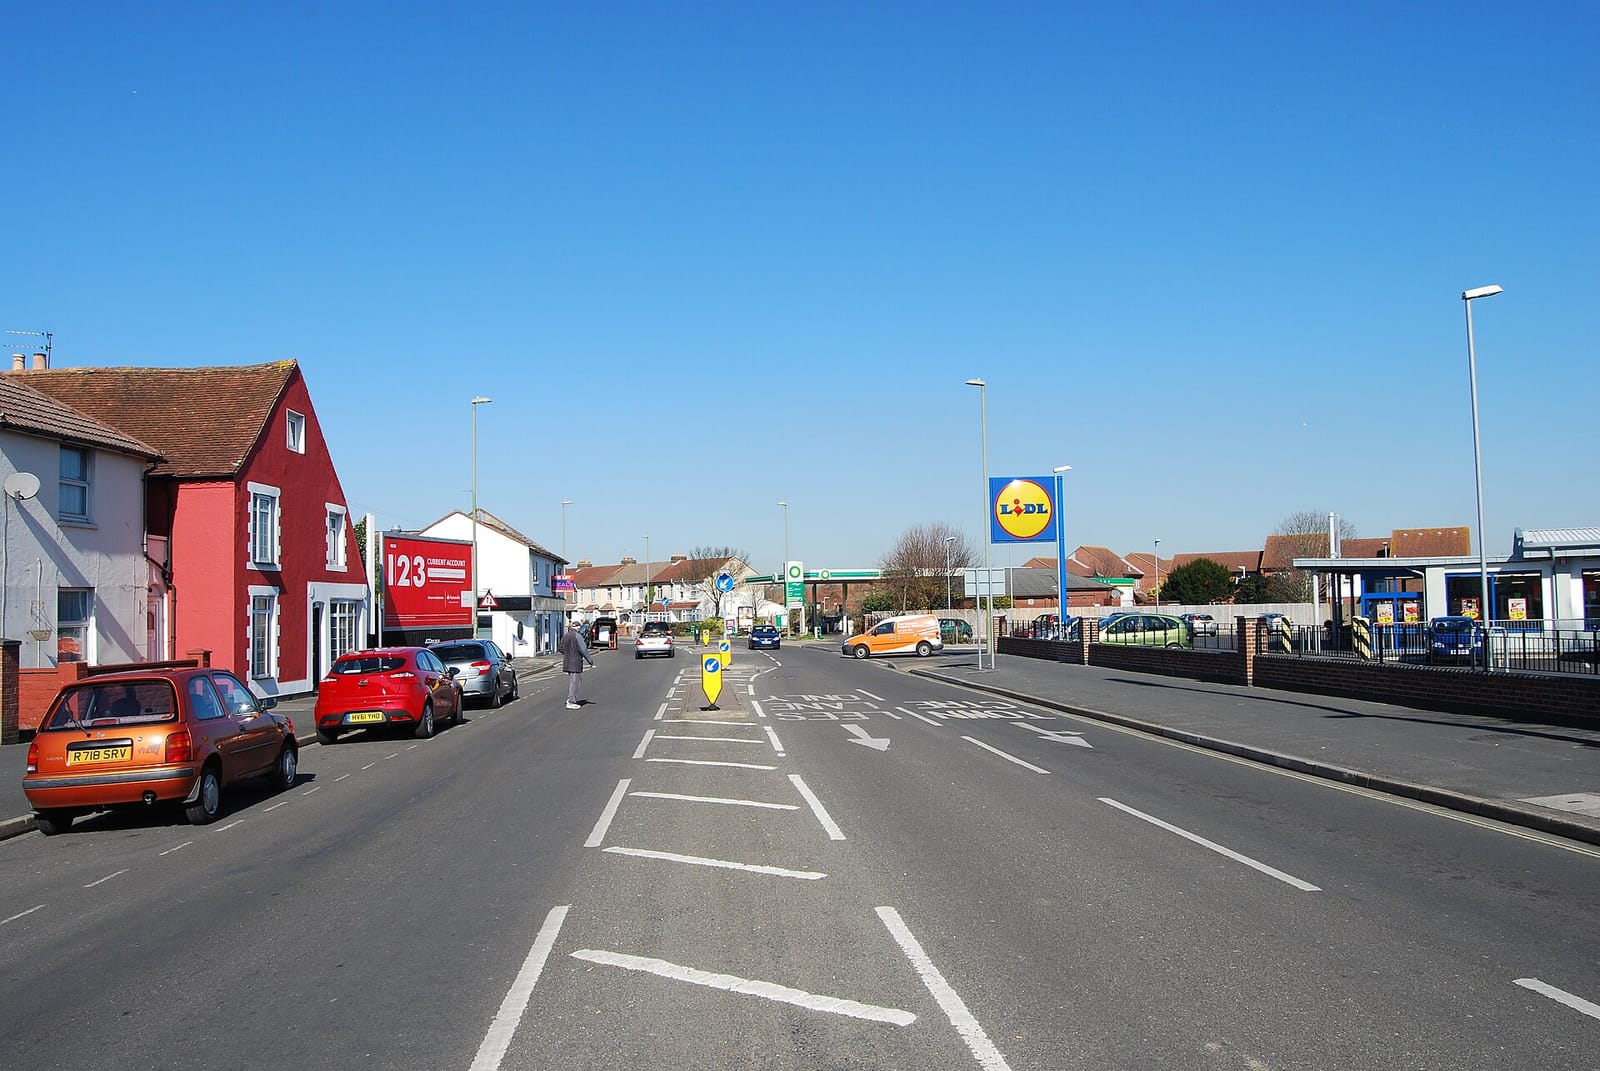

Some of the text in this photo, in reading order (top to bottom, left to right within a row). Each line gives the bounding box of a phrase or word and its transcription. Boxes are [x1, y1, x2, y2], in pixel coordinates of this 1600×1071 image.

[427, 558, 447, 567] CURRENT
[447, 559, 466, 568] ACCOUNT
[761, 694, 862, 702] ONLY
[767, 701, 880, 711] LANE
[903, 700, 1018, 710] CTRE
[776, 711, 902, 721] LEES
[926, 709, 1057, 720] TOWN
[73, 751, 100, 763] R718
[103, 749, 127, 760] SRV
